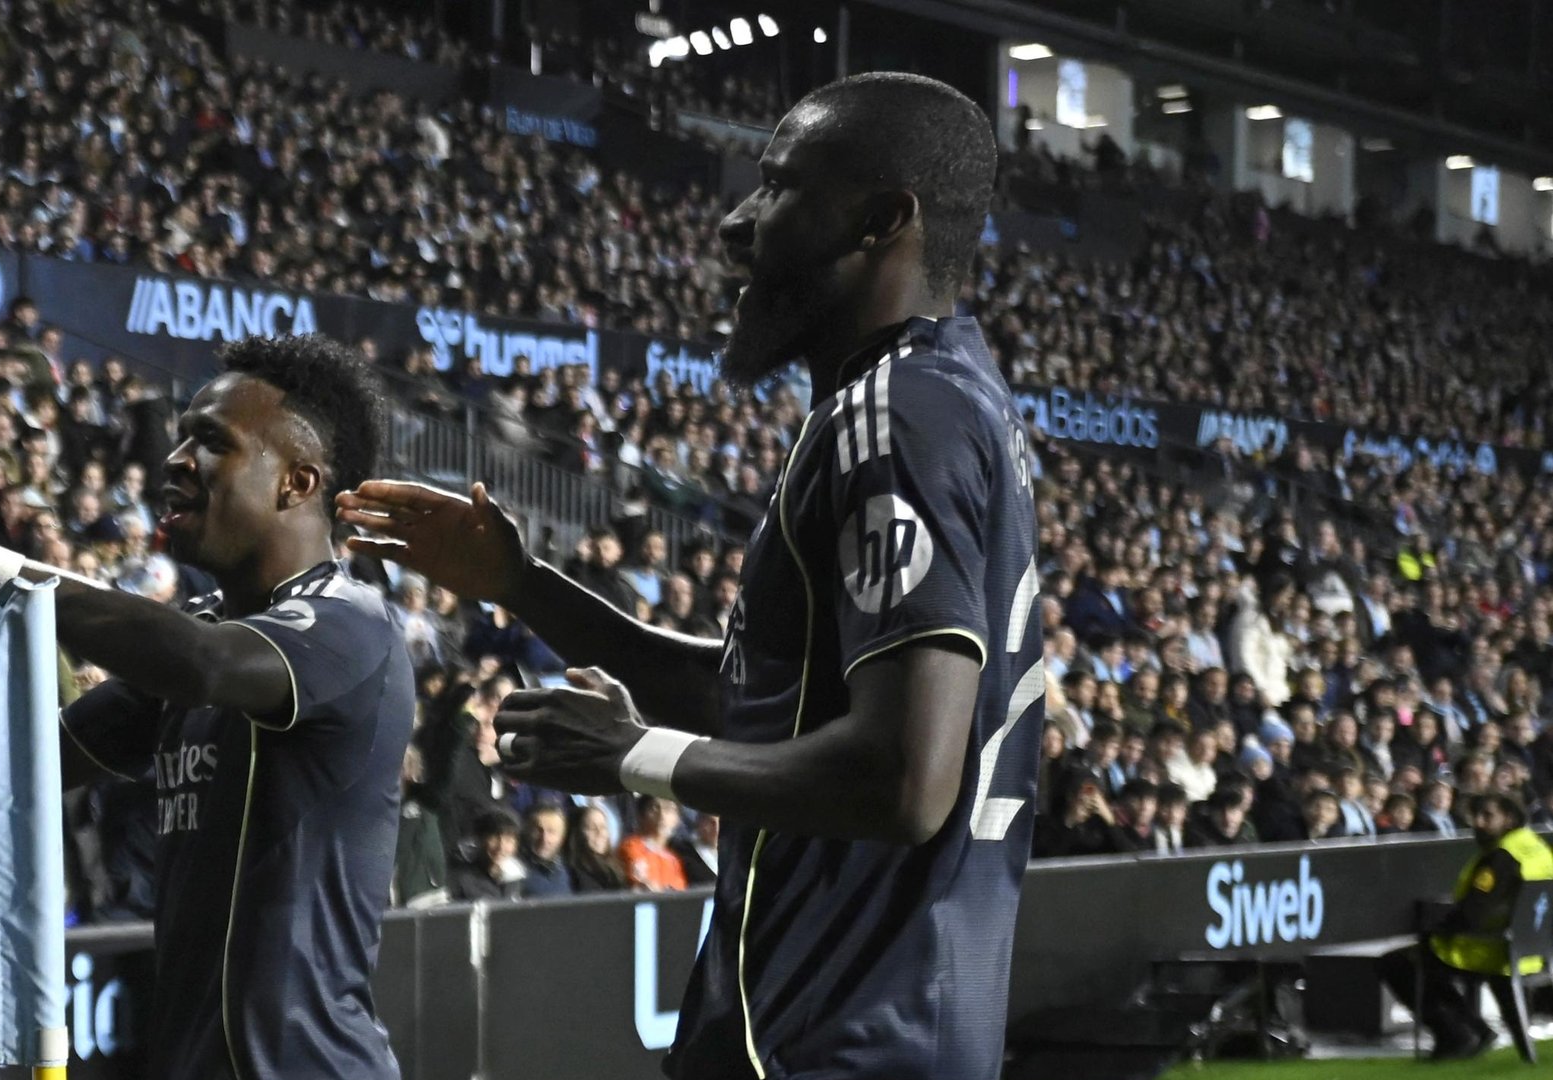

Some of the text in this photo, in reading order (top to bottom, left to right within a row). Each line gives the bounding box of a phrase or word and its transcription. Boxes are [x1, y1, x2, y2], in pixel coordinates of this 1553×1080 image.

[145, 278, 317, 342] ABANCA
[856, 503, 918, 613] hp
[1205, 853, 1324, 949] Siweb
